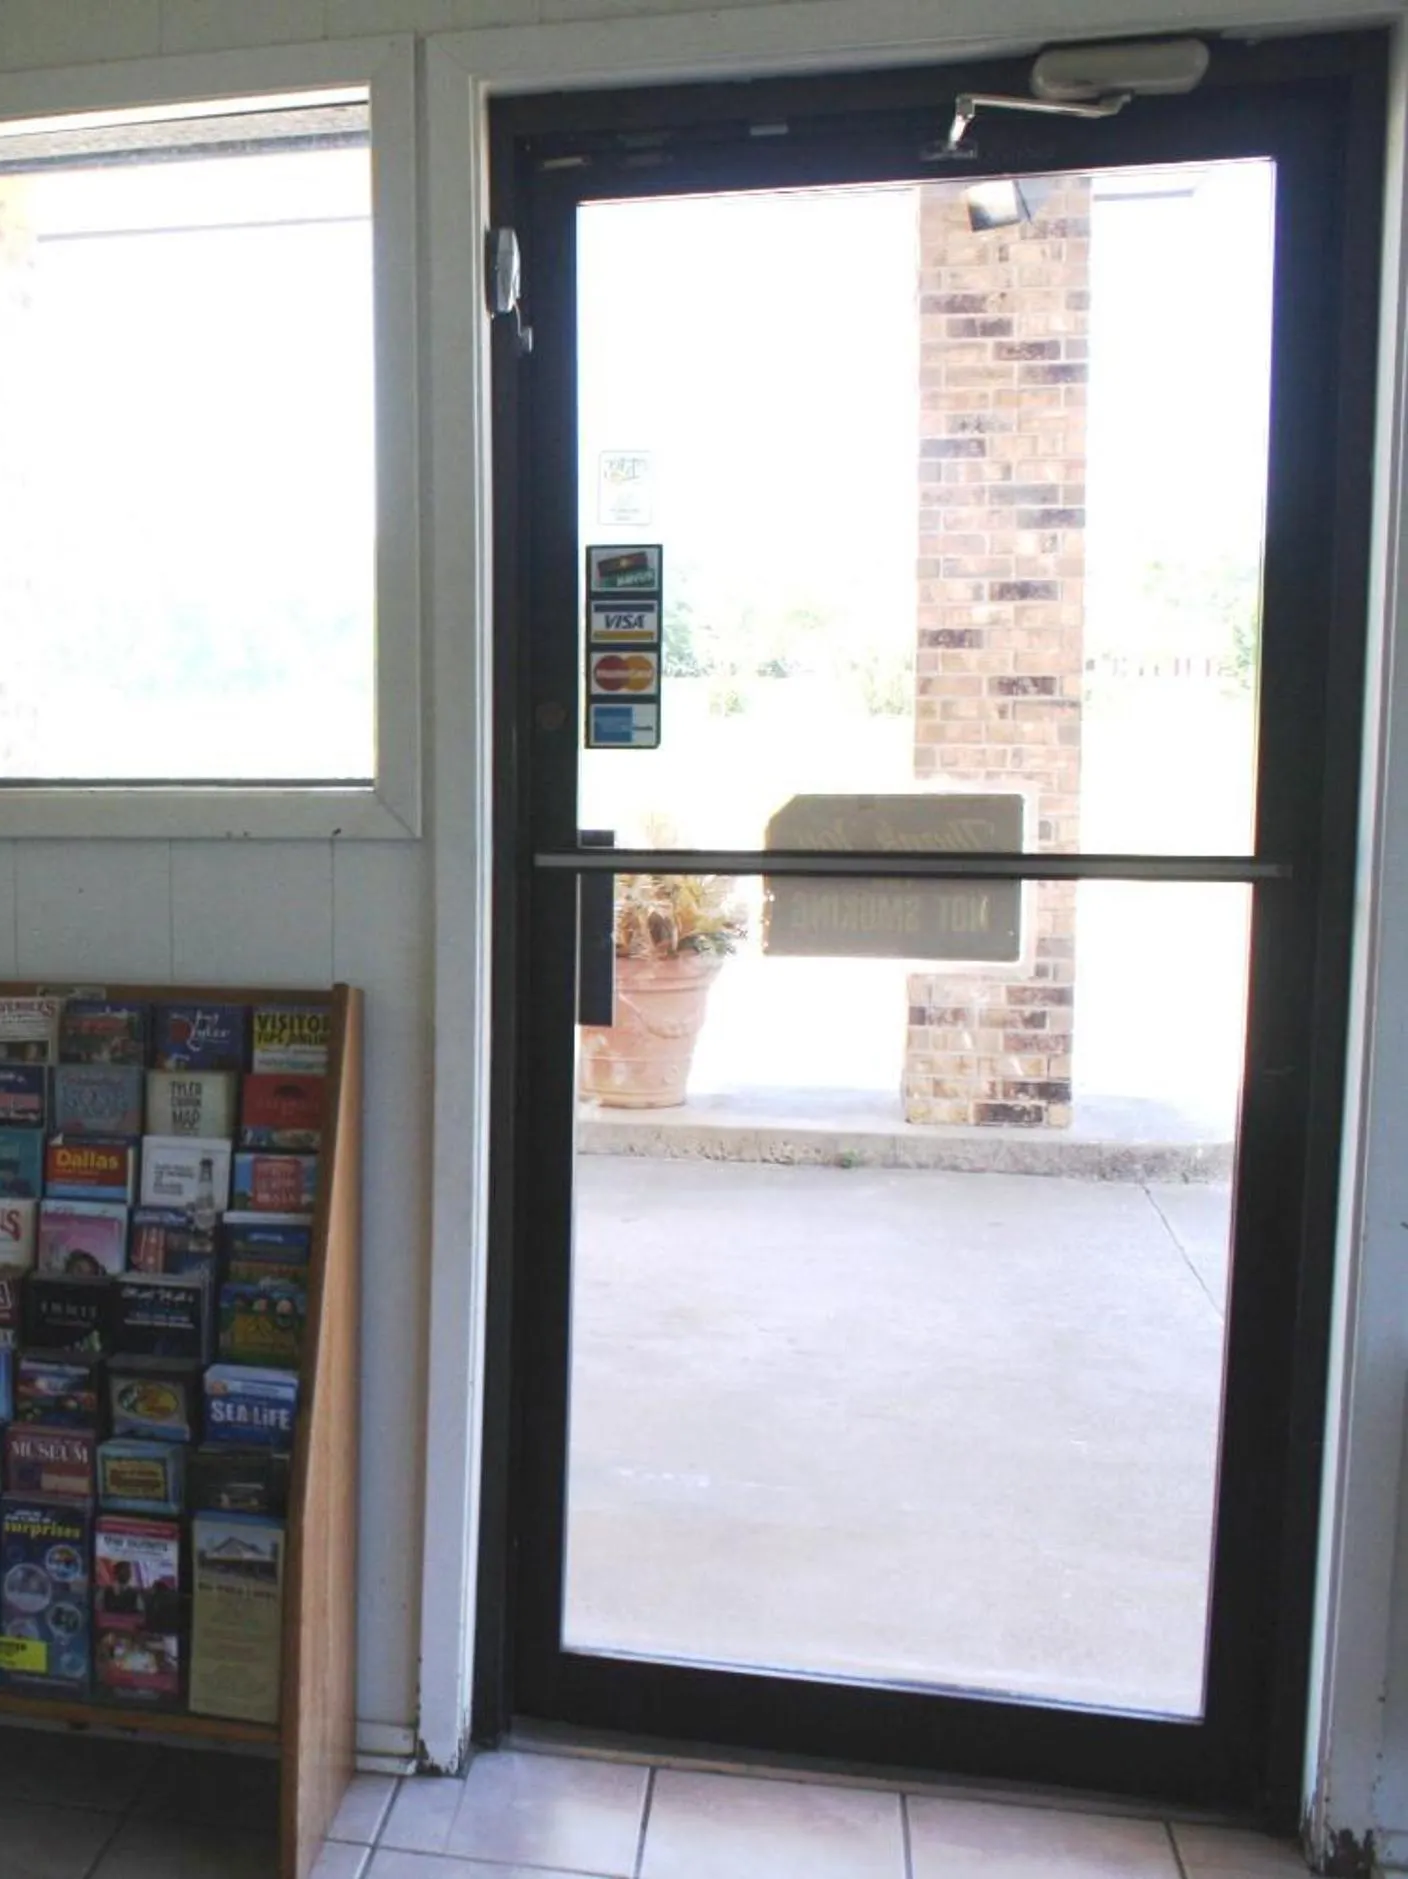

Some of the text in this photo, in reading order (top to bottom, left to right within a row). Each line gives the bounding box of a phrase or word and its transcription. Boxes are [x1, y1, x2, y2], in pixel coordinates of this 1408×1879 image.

[604, 613, 645, 630] VISA
[56, 1148, 119, 1170] Dallas
[210, 1401, 248, 1423] SEA
[10, 1439, 89, 1464] MUSEUM
[3, 1519, 81, 1540] surprises
